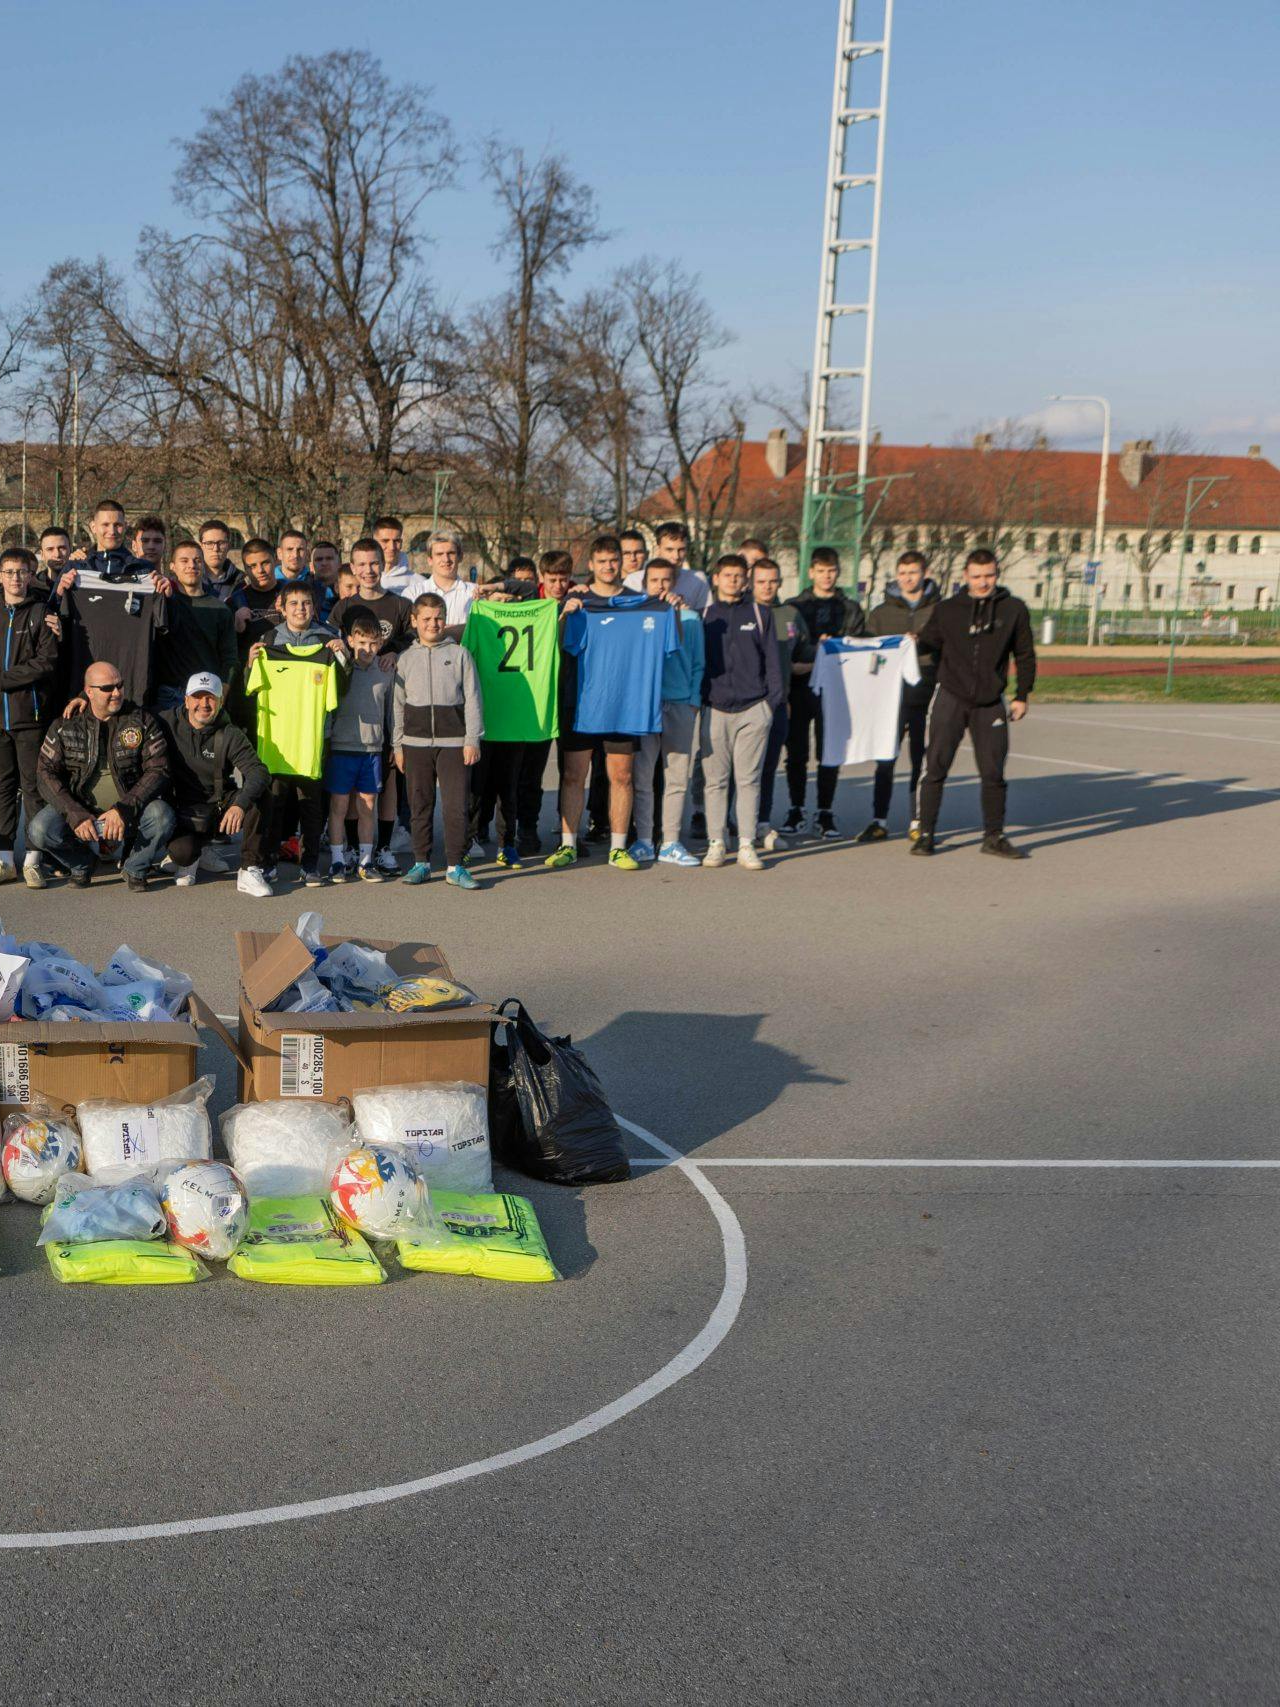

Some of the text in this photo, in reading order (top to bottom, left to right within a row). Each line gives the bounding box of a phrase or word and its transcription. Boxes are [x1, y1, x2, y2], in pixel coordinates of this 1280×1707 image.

[497, 625, 534, 672] 21
[18, 1043, 30, 1103] 101686.060
[313, 1033, 324, 1095] 100285.100
[122, 1122, 131, 1160] TOPSTAR
[405, 1128, 444, 1137] TOPSTAR
[451, 1134, 486, 1152] TOPSTAR
[182, 1179, 215, 1200] KELM
